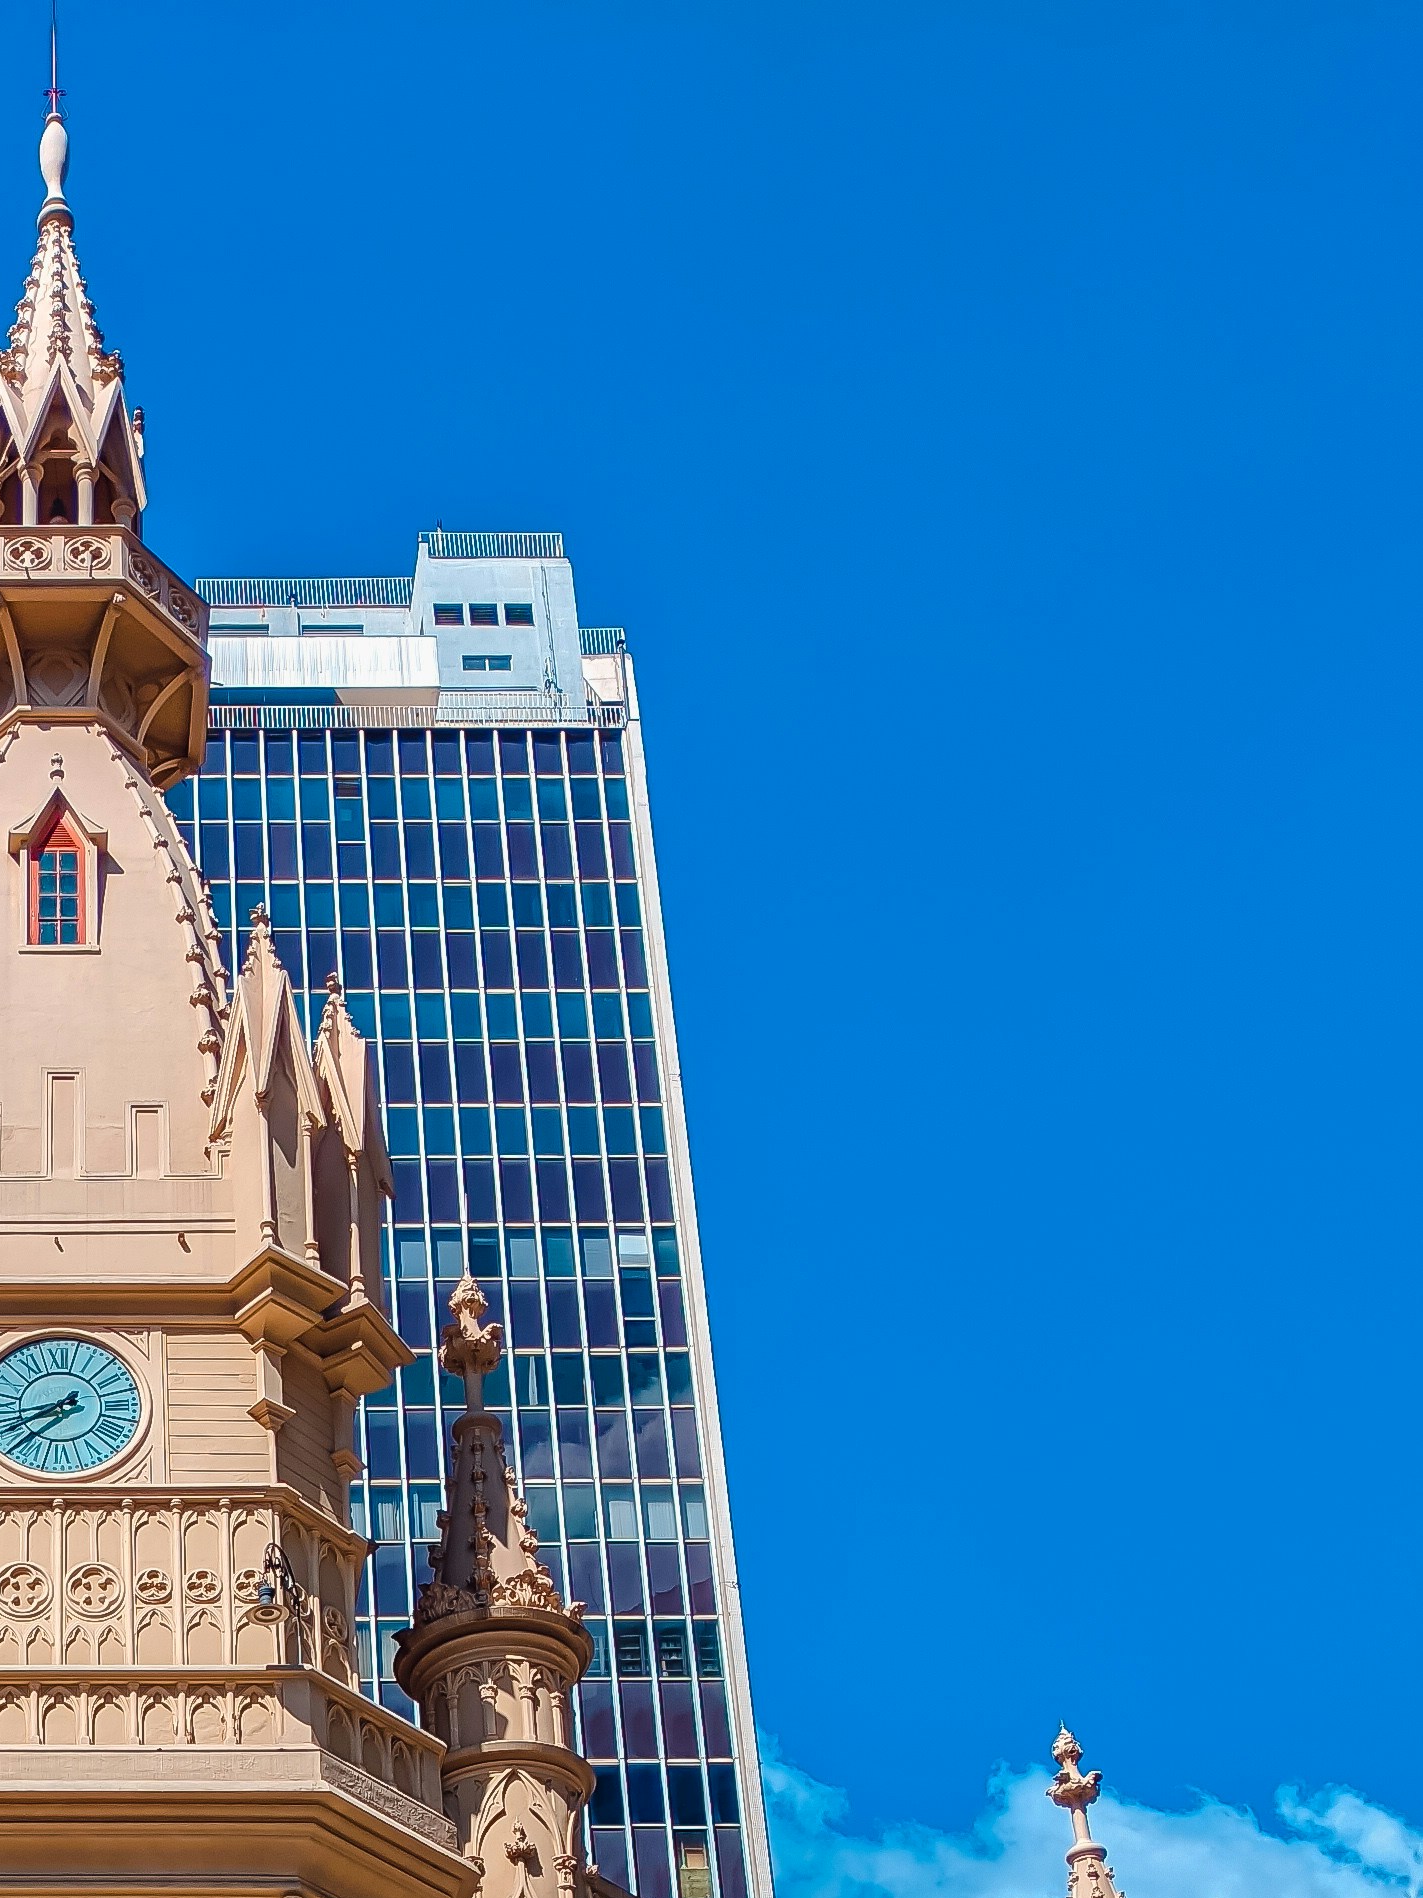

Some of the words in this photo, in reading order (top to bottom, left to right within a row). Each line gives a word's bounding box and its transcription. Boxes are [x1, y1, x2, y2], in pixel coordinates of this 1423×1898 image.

[18, 1353, 43, 1379] XI
[47, 1347, 69, 1370] XII
[104, 1399, 130, 1411] III
